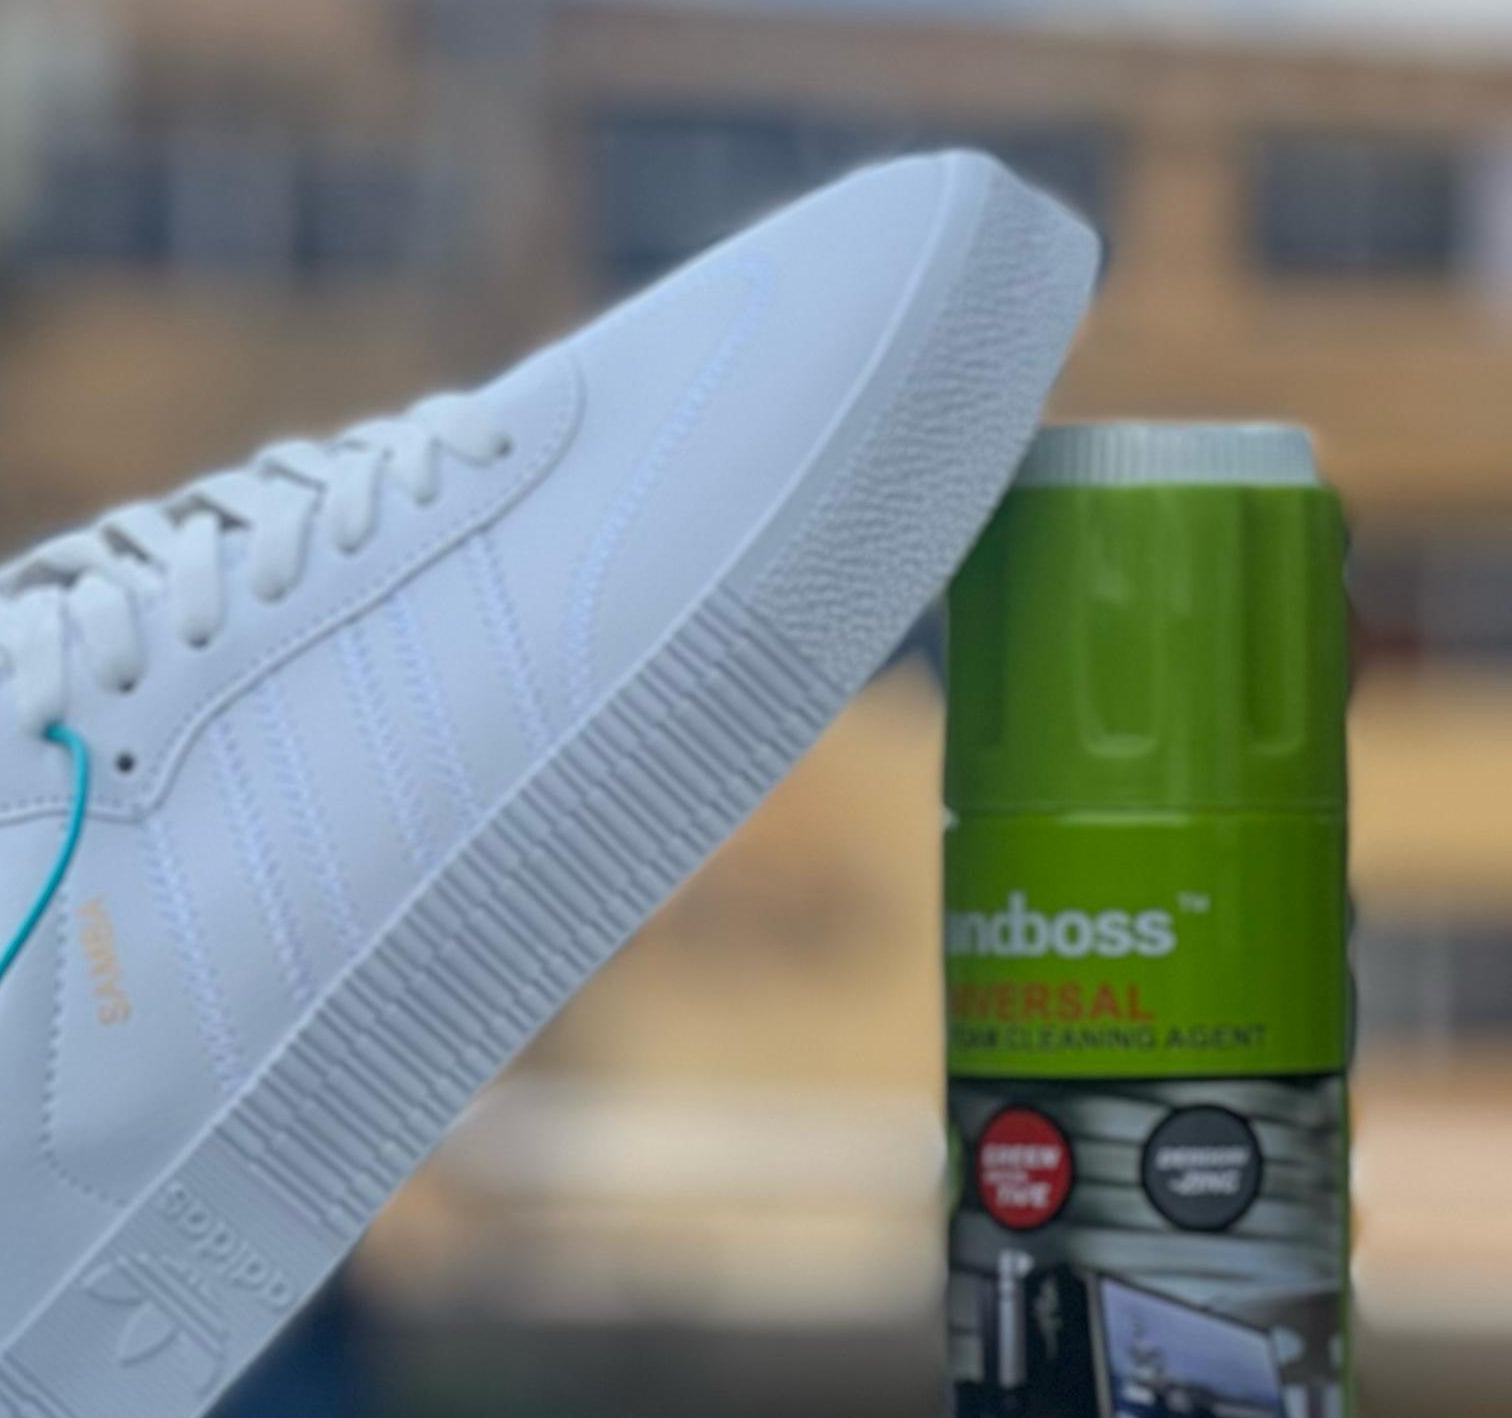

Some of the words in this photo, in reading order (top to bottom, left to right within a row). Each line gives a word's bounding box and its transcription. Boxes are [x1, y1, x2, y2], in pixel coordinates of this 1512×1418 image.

[1005, 1024, 1156, 1051] CLEANING
[1165, 1023, 1267, 1049] AGENT
[159, 1181, 292, 1311] adidas
